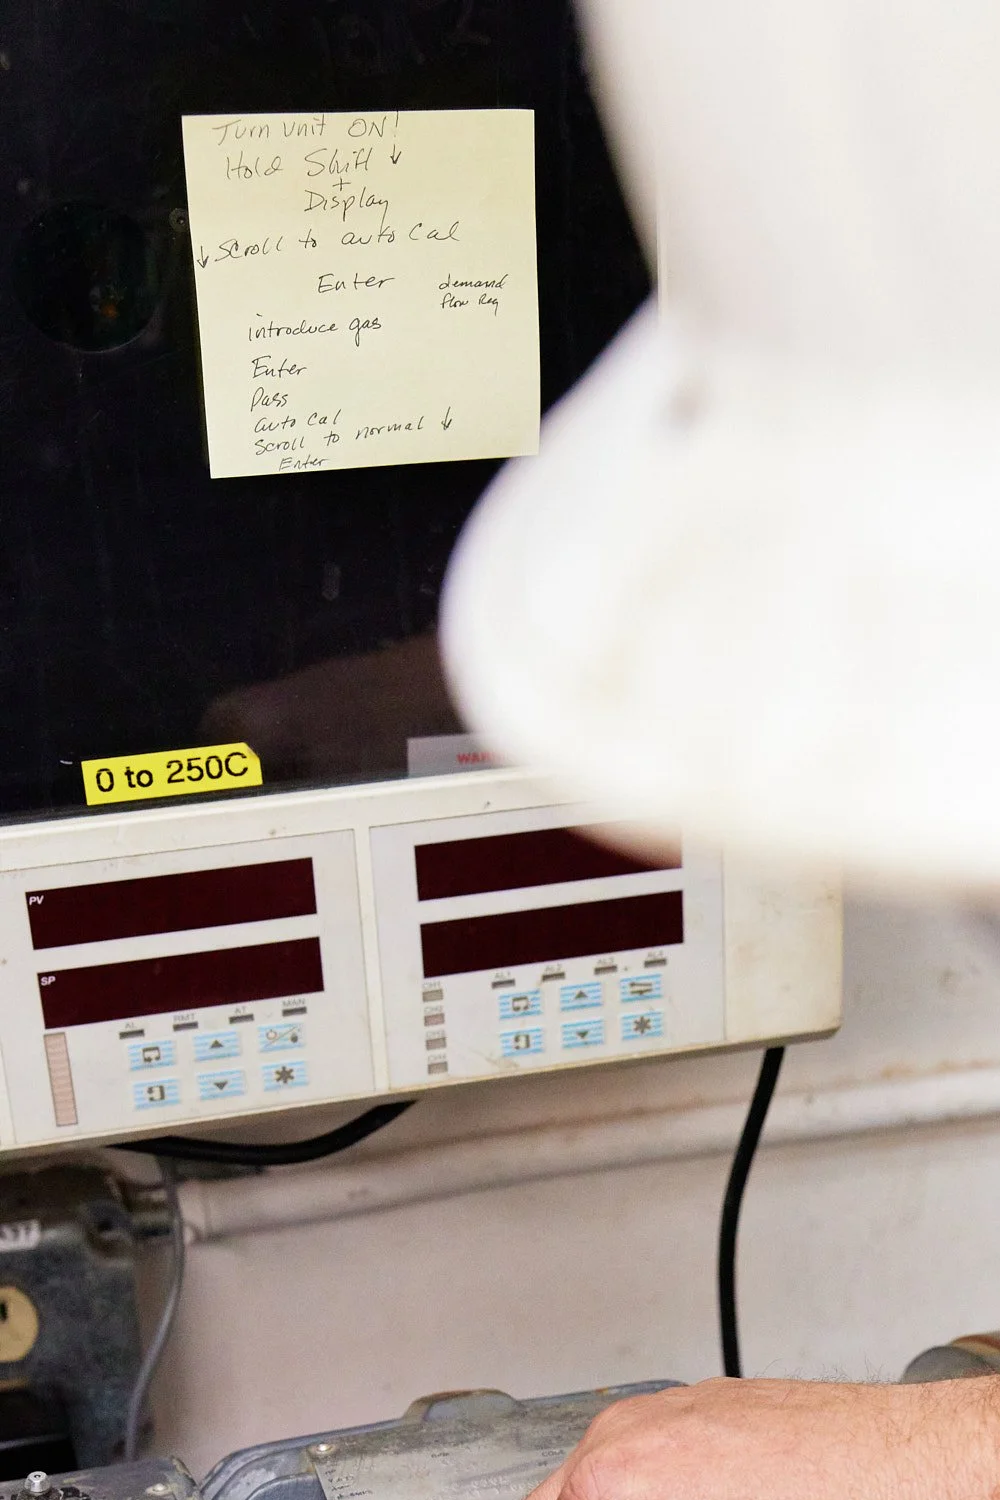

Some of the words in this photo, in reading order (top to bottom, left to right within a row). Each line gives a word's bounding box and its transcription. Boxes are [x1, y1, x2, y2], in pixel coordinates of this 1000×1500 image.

[211, 119, 270, 145] Turn
[226, 151, 283, 180] Hold
[304, 188, 388, 230] Display
[299, 229, 317, 249] to
[341, 225, 395, 246] auto
[409, 221, 460, 242] Cal
[318, 274, 395, 293] Enter
[439, 274, 508, 290] demand
[248, 314, 338, 341] introduce
[349, 317, 381, 346] gas
[252, 355, 307, 378] Enter
[251, 387, 288, 411] Pass
[308, 409, 341, 426] Cal
[255, 437, 305, 456] Scroll
[324, 431, 340, 446] to
[355, 416, 424, 440] normal
[279, 457, 329, 471] Enter
[96, 768, 114, 792] 0
[124, 767, 153, 788] to
[166, 752, 249, 784] 250C
[29, 895, 44, 906] PV
[41, 975, 56, 986] SP
